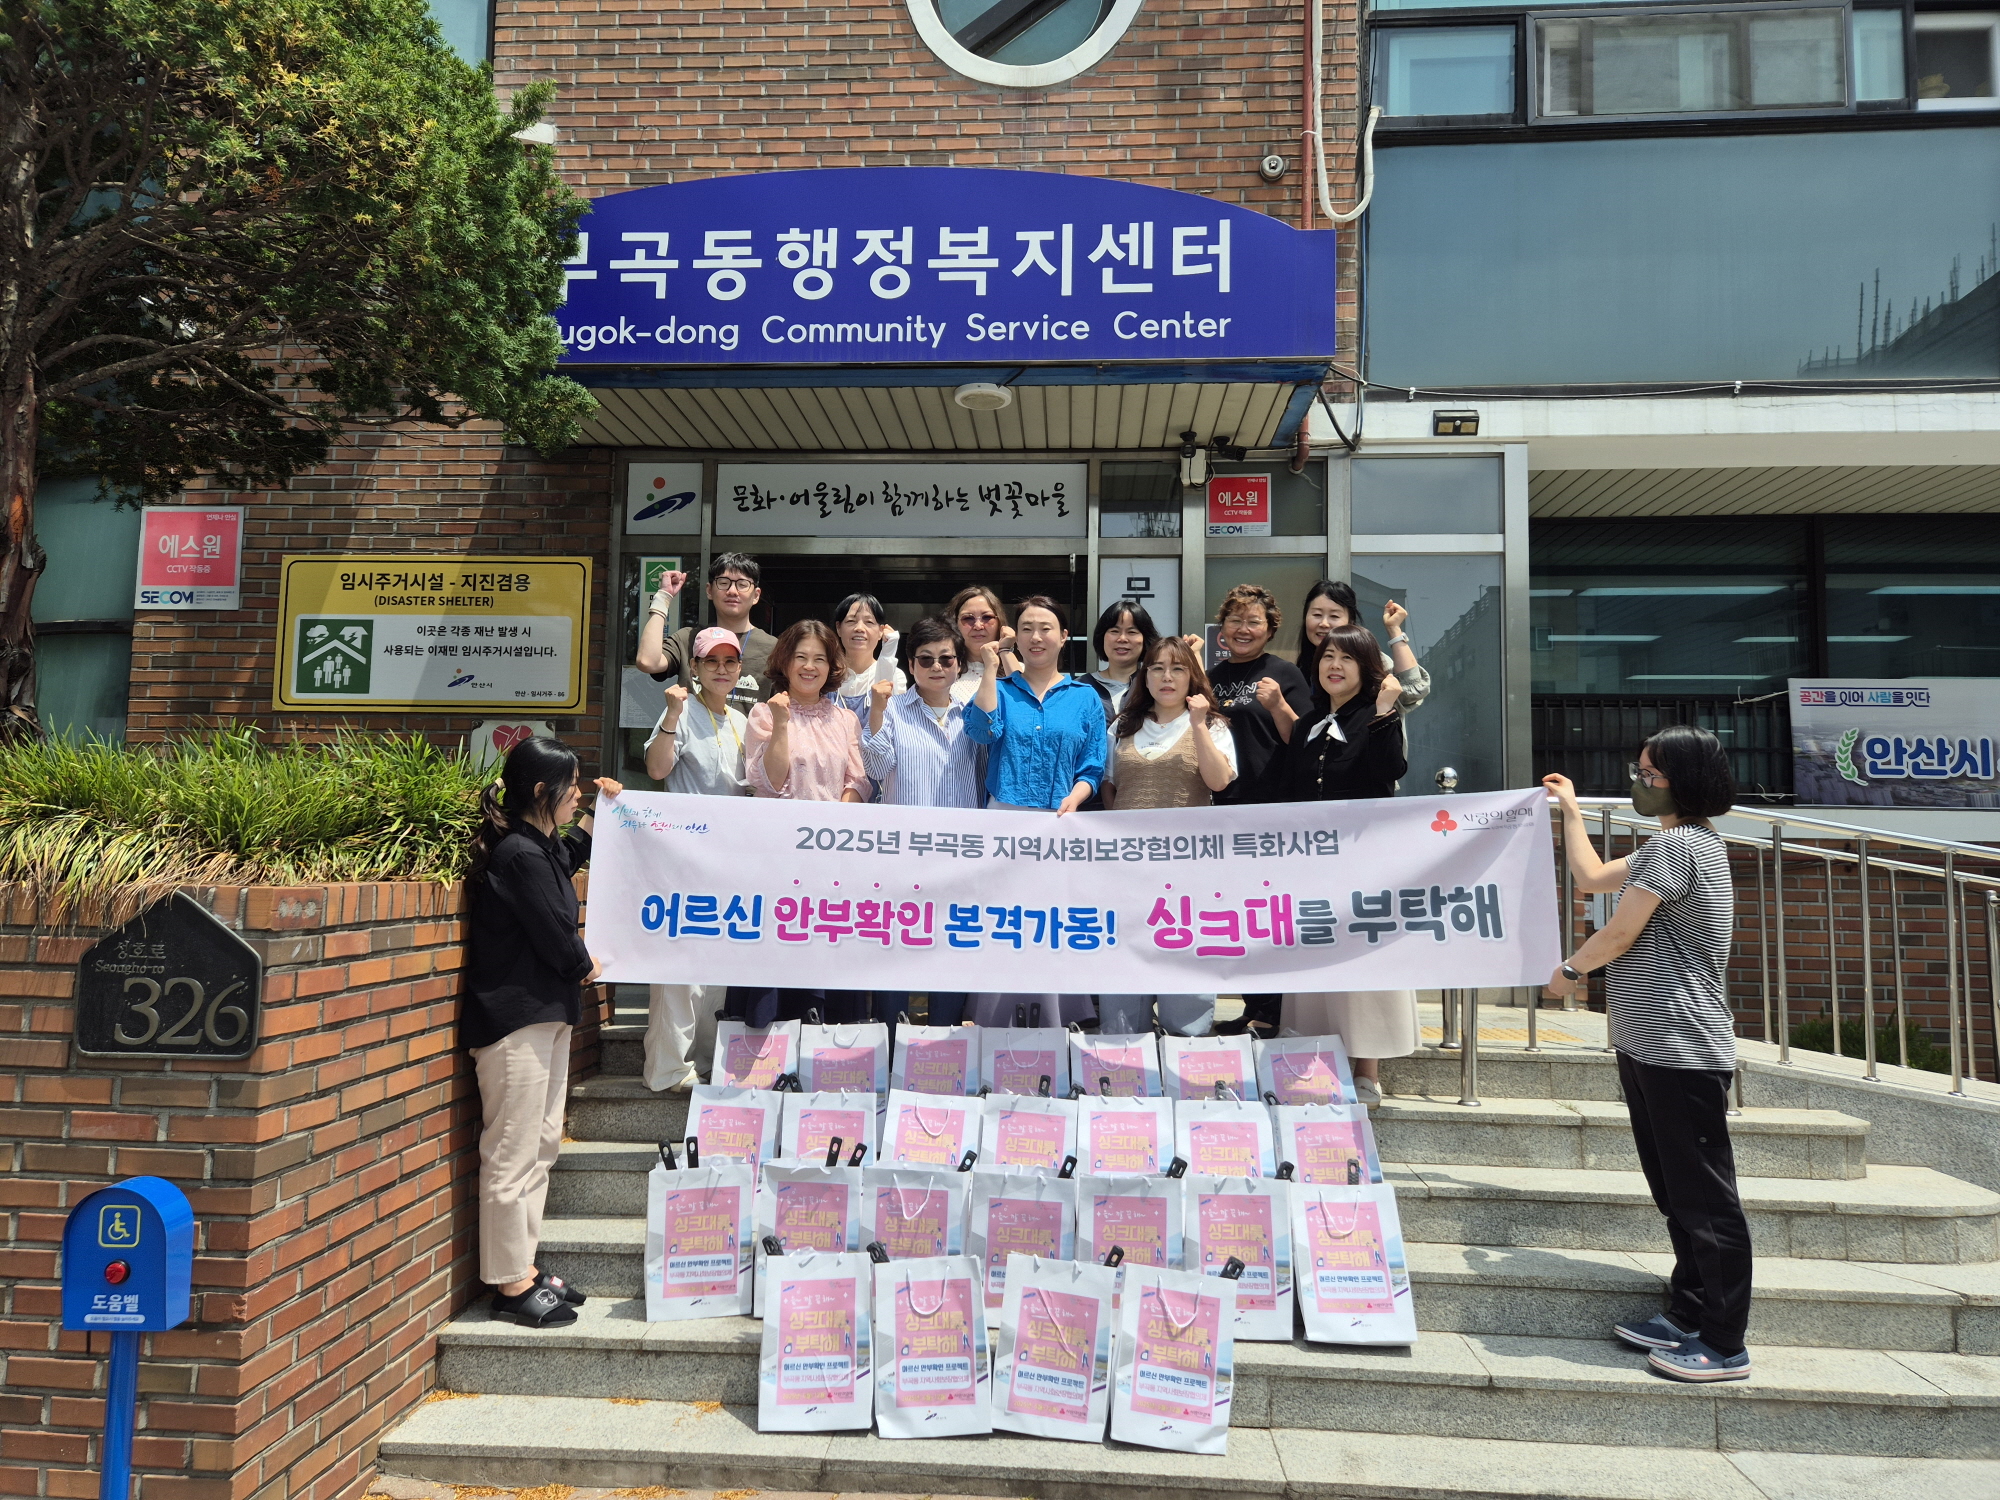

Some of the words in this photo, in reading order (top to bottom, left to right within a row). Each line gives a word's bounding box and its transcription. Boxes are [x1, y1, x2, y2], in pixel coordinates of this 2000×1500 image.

[555, 317, 739, 350] ugok-dong
[762, 315, 947, 348] Community
[966, 314, 1090, 341] Service
[1114, 311, 1231, 338] Center
[883, 482, 970, 517] 함께하는
[978, 482, 1070, 520] 벚꽃마을
[1218, 491, 1257, 506] 에스원
[1209, 526, 1242, 534] SECOM
[159, 535, 221, 558] 에스원
[167, 565, 187, 573] CCTV
[341, 573, 444, 592] 임시주거시설
[461, 573, 531, 592] 지진겸용
[141, 591, 193, 604] SECOM
[374, 595, 435, 607] (DISASTER
[438, 596, 494, 608] SHELTER)
[416, 625, 447, 637] 이곳은
[450, 625, 471, 637] 각종
[474, 625, 495, 637] 재난
[498, 625, 518, 637] 발생
[522, 625, 531, 637] 시
[384, 645, 425, 657] 사용되는
[428, 645, 458, 657] 이재민
[461, 645, 557, 658] 임시주거시설입니다.
[1800, 691, 1836, 703] 공간을
[1840, 691, 1863, 705] 이어
[1868, 691, 1904, 703] 사람을
[1906, 691, 1930, 706] 잇다
[1866, 738, 1990, 776] 안산시
[685, 823, 710, 833] 안산
[796, 827, 901, 854] 2025년
[909, 832, 984, 858] 부곡동
[993, 834, 1225, 862] 지역사회보장협의체
[1232, 831, 1340, 859] 특화사업
[642, 893, 762, 940] 어르신
[775, 897, 934, 946] 안부확인
[945, 904, 1116, 949] 본격가동!
[1147, 893, 1338, 958] 싱크대를
[1348, 883, 1503, 943] 부탁해
[115, 940, 166, 959] 성호로
[95, 960, 165, 974] Seongho-ro
[114, 977, 248, 1046] 326
[1002, 1074, 1040, 1087] 싱크대
[674, 1214, 731, 1232] 싱크대를
[785, 1210, 839, 1227] 싱크대를
[790, 1231, 831, 1247] 부탁해
[996, 1227, 1052, 1245] 싱크대를
[1102, 1225, 1158, 1243] 싱크대를
[1208, 1224, 1264, 1241] 싱크대를
[680, 1235, 724, 1251] 부탁해
[1327, 1252, 1371, 1267] 부탁해
[91, 1294, 138, 1312] 도움벨
[789, 1310, 847, 1330] 싱크대를
[904, 1311, 963, 1332] 싱크대를
[795, 1334, 841, 1352] 부탁해
[912, 1335, 957, 1354] 부탁해
[1152, 1344, 1199, 1369] 부탁해
